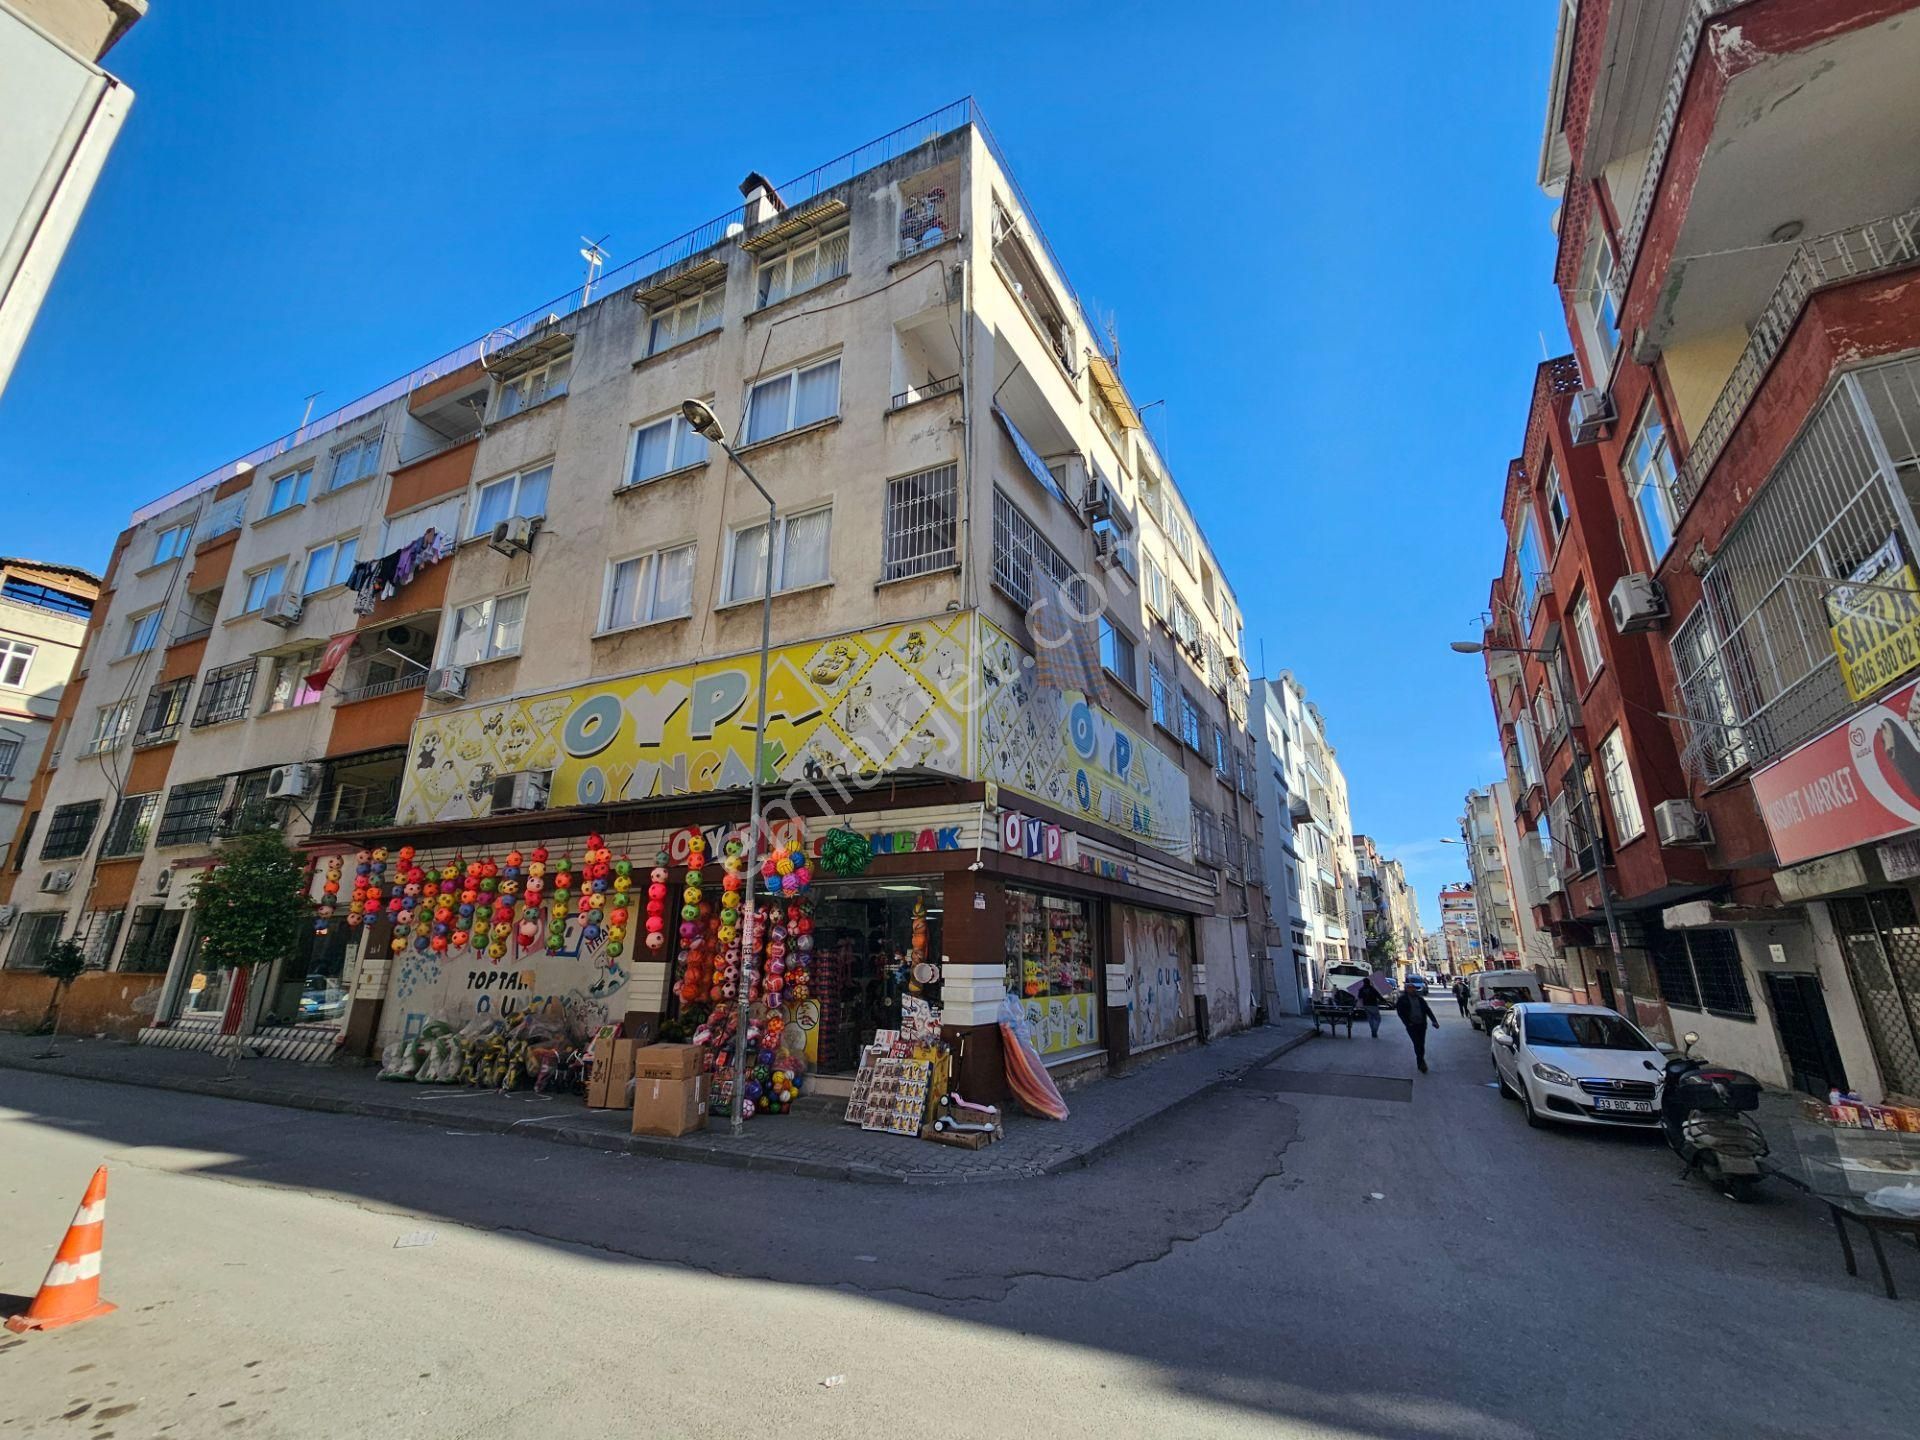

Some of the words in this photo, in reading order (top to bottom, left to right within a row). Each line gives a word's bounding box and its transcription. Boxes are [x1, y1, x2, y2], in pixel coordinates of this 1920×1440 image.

[1850, 658, 1877, 695] 0546
[1875, 644, 1899, 680] 580
[1896, 633, 1916, 666] 82
[562, 653, 827, 759] OYPA
[1802, 766, 1859, 817] MARKET
